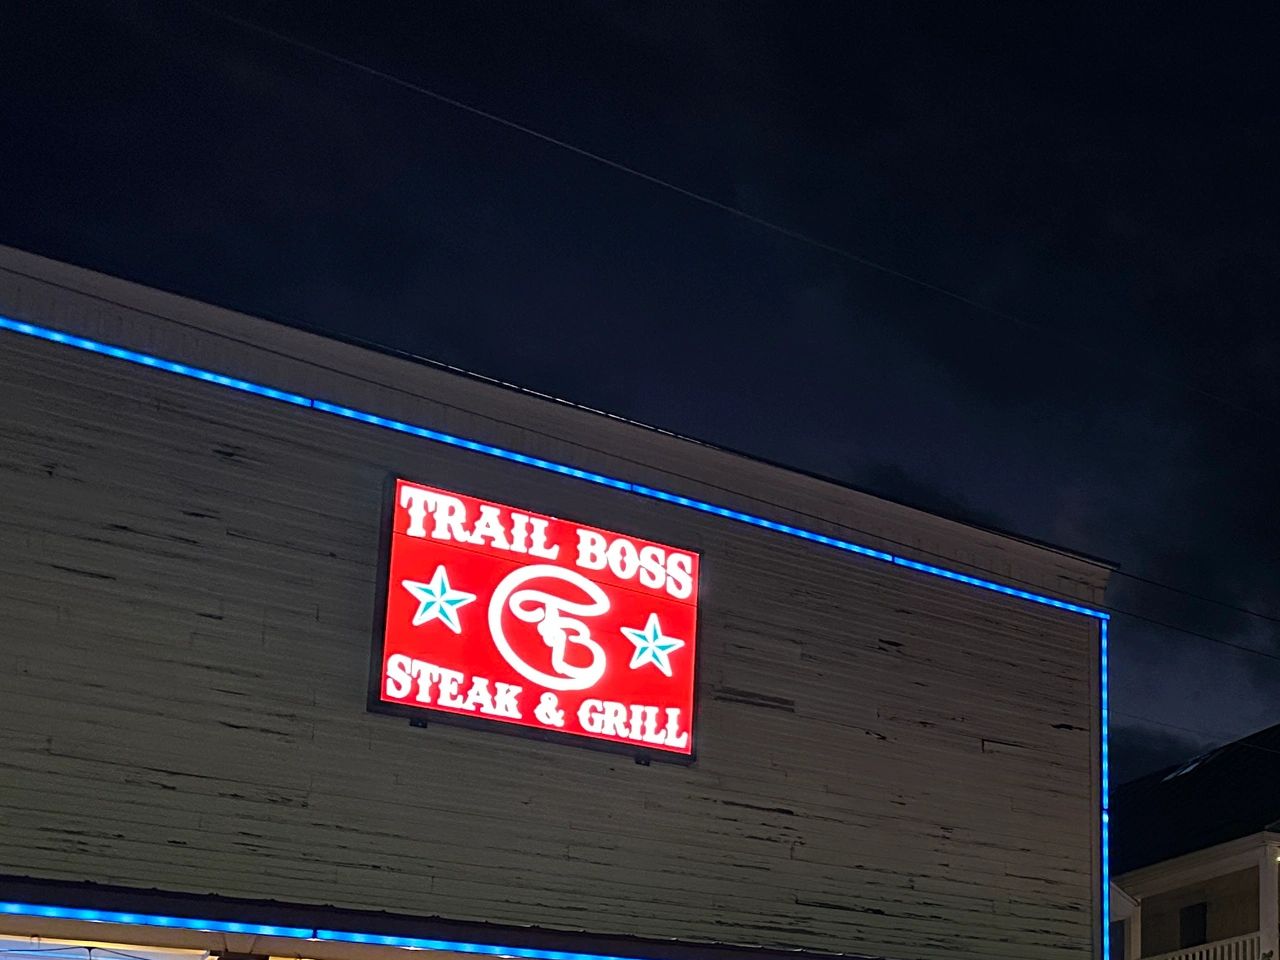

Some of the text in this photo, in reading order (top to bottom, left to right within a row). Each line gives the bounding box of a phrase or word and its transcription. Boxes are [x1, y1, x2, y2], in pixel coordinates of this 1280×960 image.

[400, 484, 693, 600] TRAIL BOSS
[386, 653, 689, 749] STEAK & GRILL
